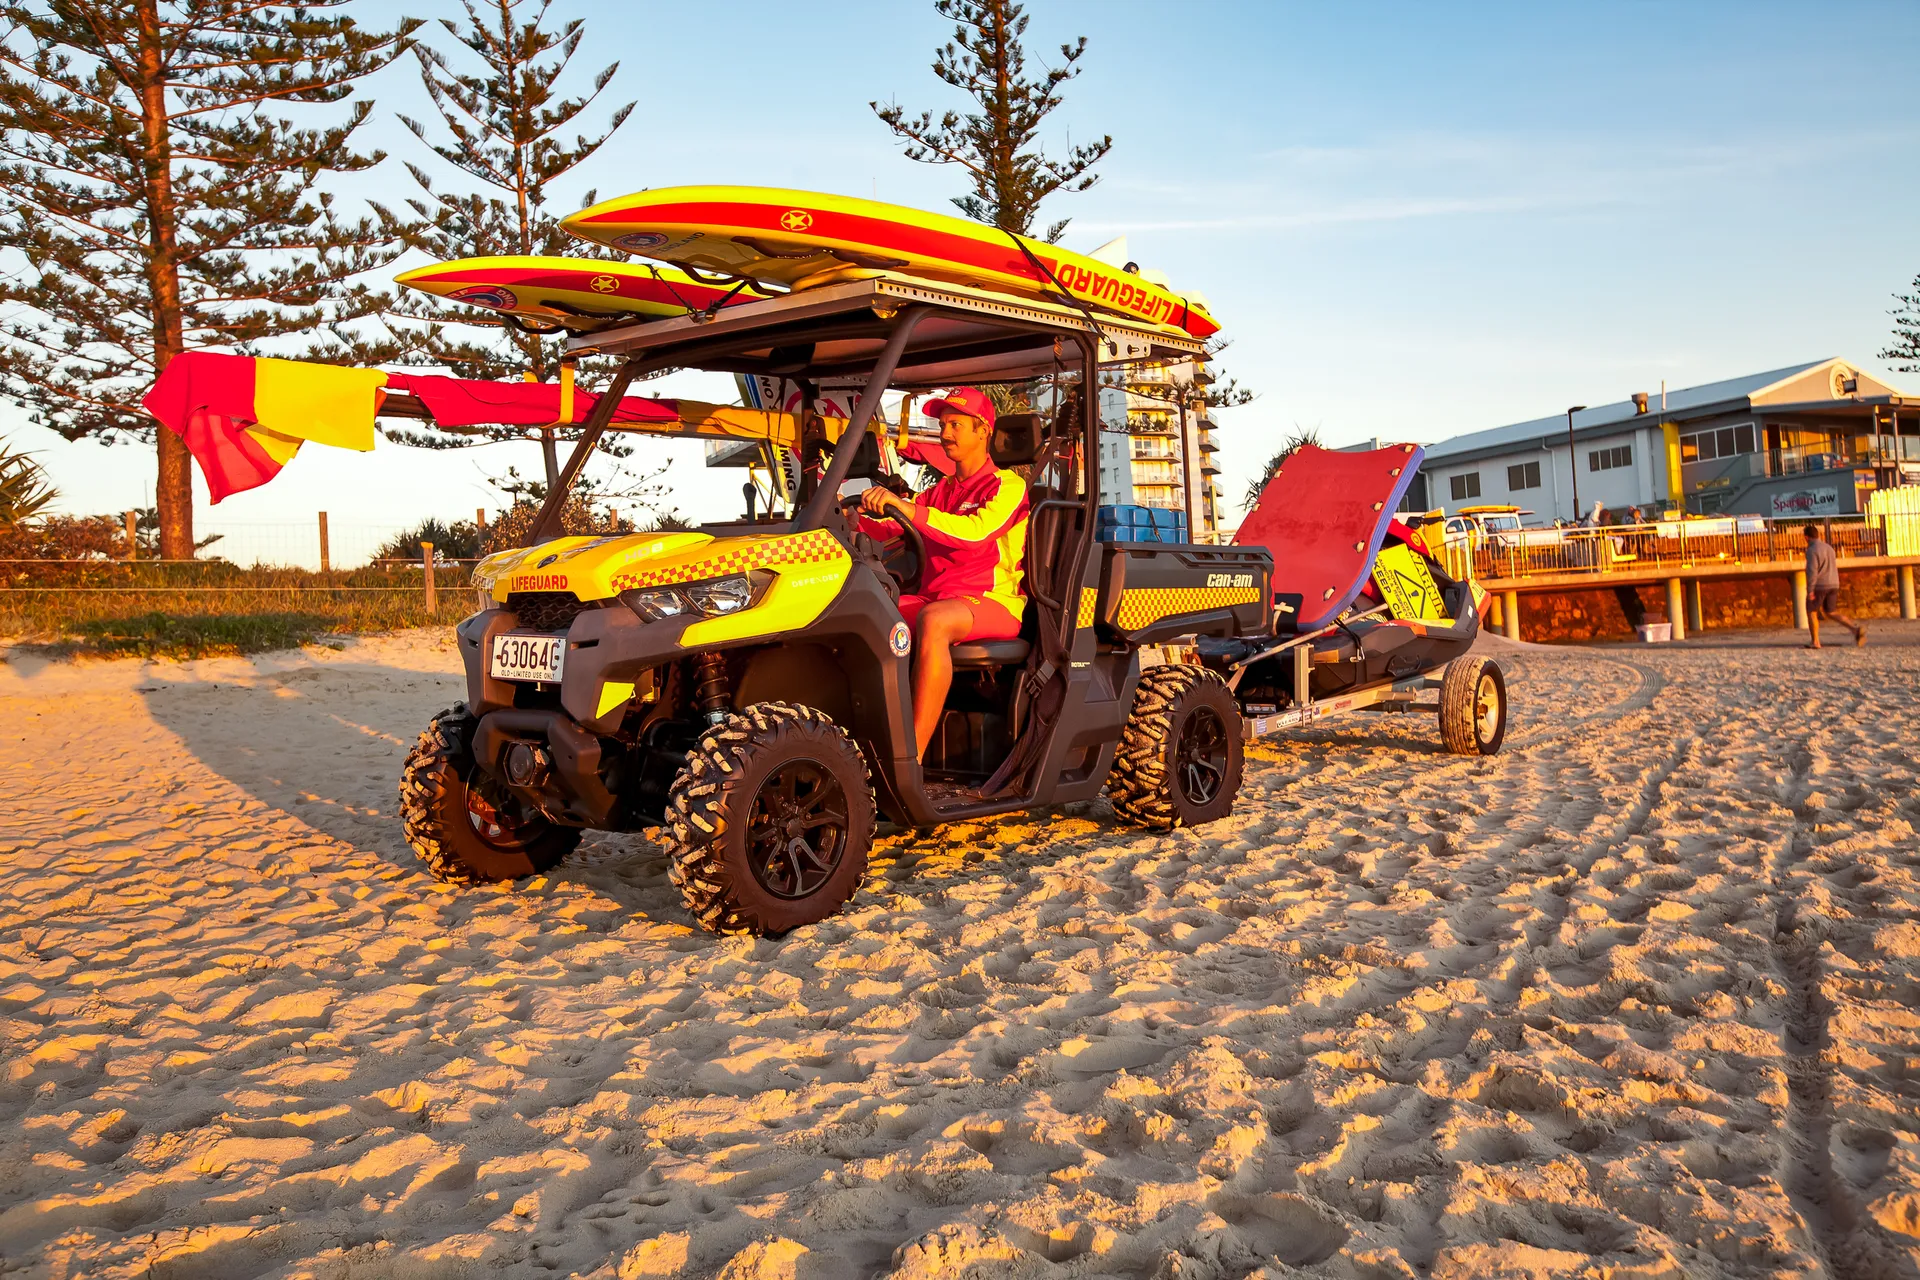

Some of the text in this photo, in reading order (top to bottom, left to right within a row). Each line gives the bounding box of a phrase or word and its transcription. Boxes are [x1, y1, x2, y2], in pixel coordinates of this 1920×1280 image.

[1057, 264, 1172, 322] LIFEGUARD
[760, 376, 774, 399] NO
[511, 575, 569, 591] LIFEGUARD
[791, 573, 840, 588] DEFENDER
[1373, 562, 1391, 594] KEEP
[1411, 553, 1448, 617] WARNIN
[500, 640, 560, 671] 63064C
[533, 671, 542, 679] USE
[543, 672, 556, 680] ONLY
